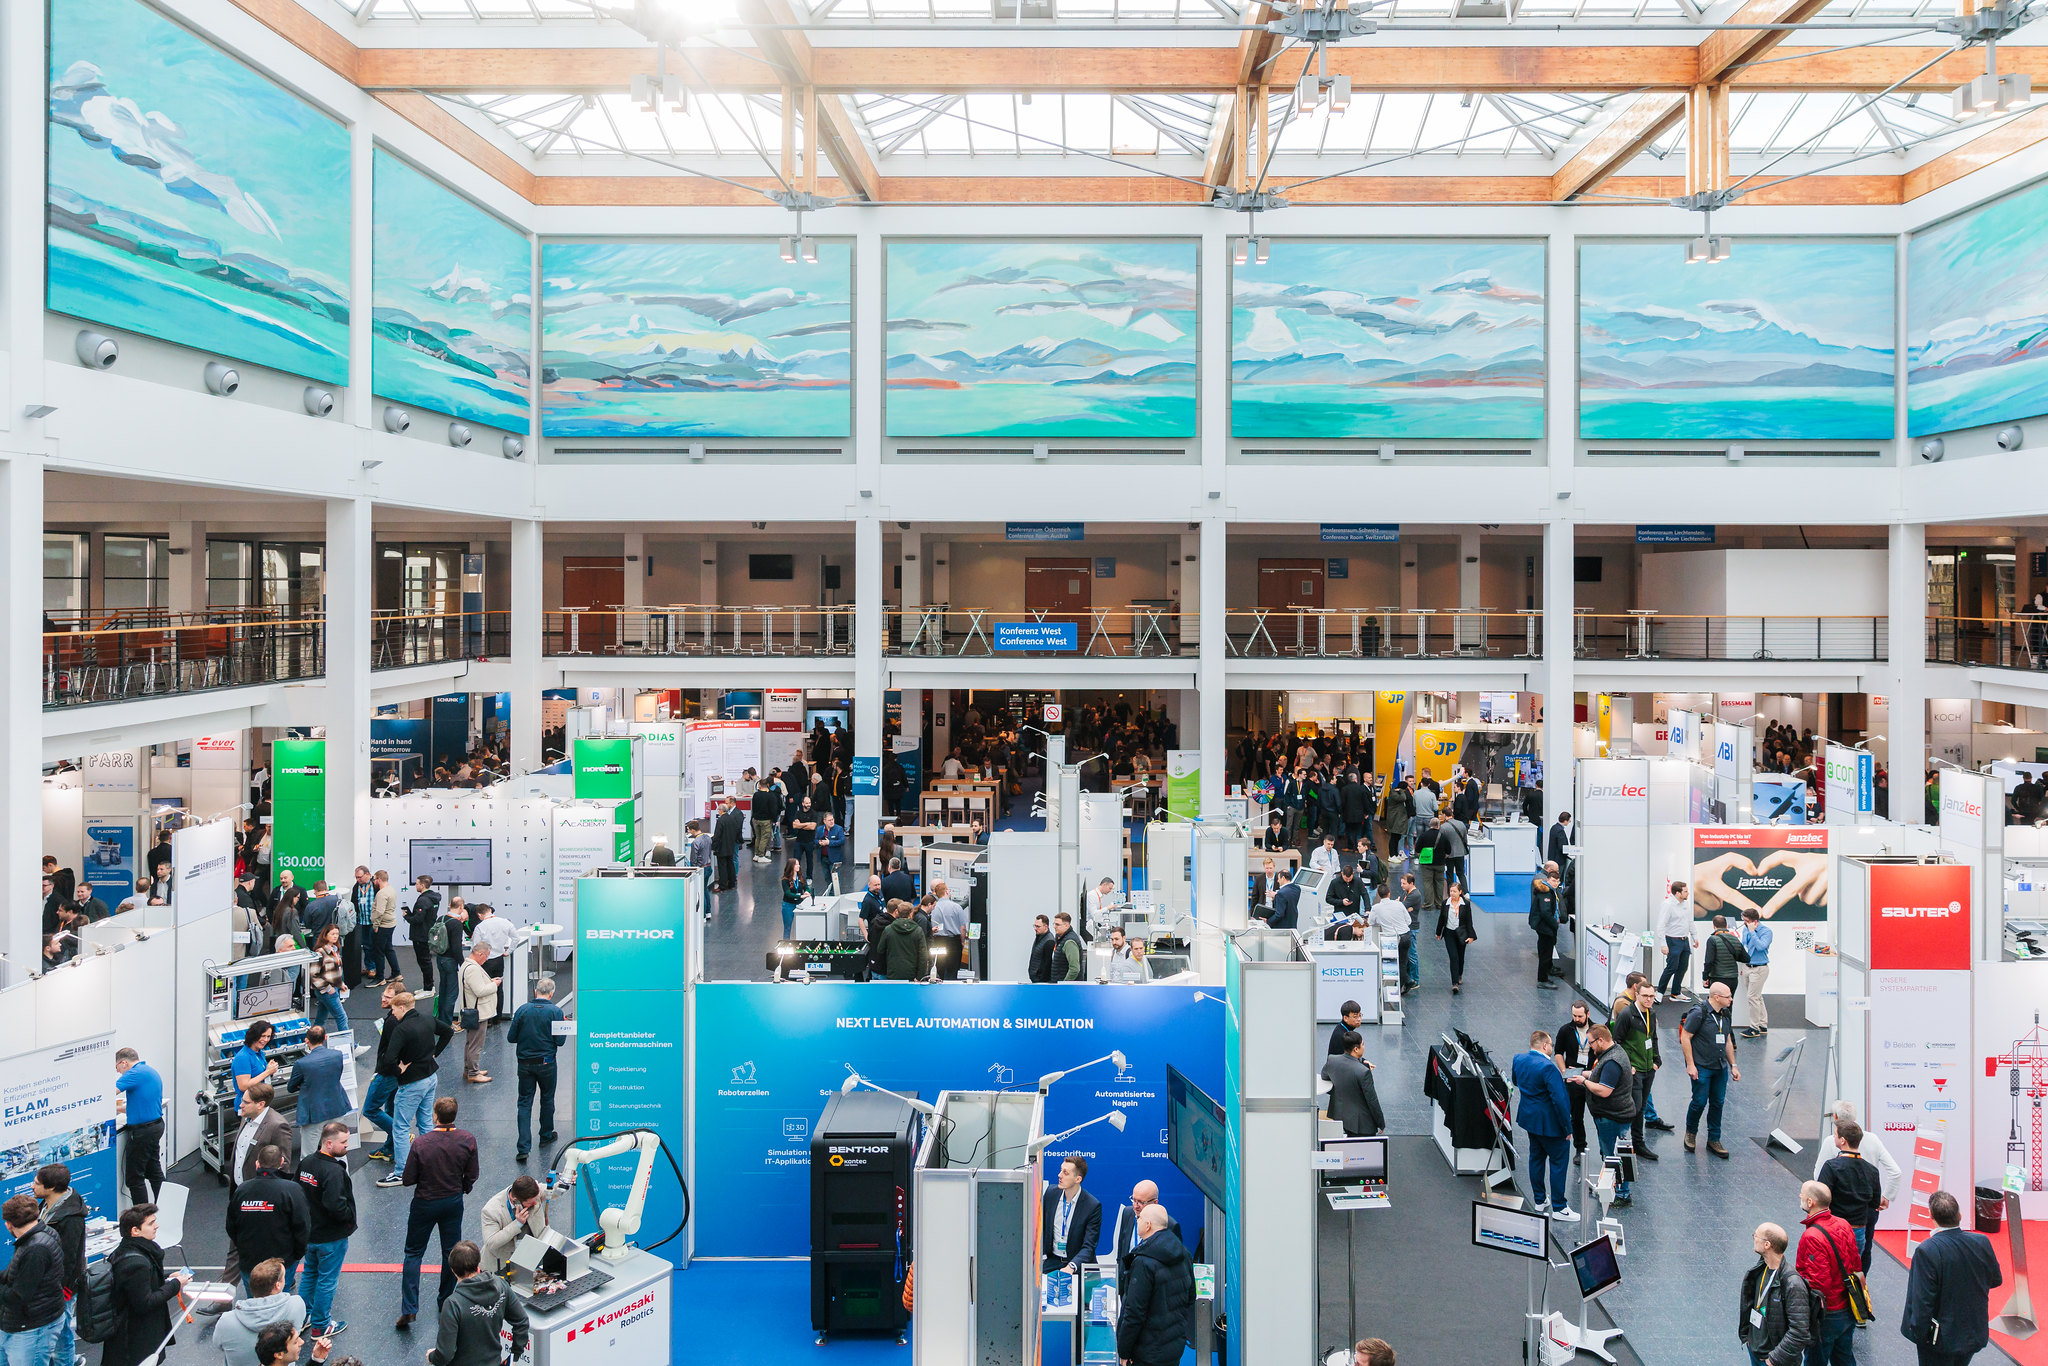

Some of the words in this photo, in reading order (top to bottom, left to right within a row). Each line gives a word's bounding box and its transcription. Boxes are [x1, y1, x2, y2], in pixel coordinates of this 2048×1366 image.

[1000, 626, 1039, 635] Konferenz
[1041, 627, 1062, 635] West
[1000, 637, 1044, 645] Conference
[1046, 637, 1067, 645] West
[770, 694, 798, 703] Seger
[1388, 694, 1404, 704] JP
[1934, 713, 1962, 722] KOCH
[648, 733, 675, 742] DIAS
[1670, 726, 1684, 745] ABI
[211, 739, 236, 747] ever
[1434, 742, 1458, 756] JP
[1717, 741, 1733, 762] ABI
[89, 752, 134, 768] FARR
[281, 766, 323, 774] norelem
[582, 764, 624, 773] norelem
[1585, 783, 1646, 799] janztec
[1942, 795, 1982, 817] janztec
[1785, 833, 1823, 843] janztec
[277, 856, 325, 868] 130.000
[1736, 876, 1783, 889] janztec
[1881, 906, 1950, 918] SAUTER
[585, 929, 675, 940] BENTHOR
[1586, 941, 1608, 967] janztec
[1321, 967, 1364, 977] KISTLER
[1879, 976, 1907, 984] UNSERE
[1879, 985, 1938, 993] SYSTEMPARTNER
[836, 1017, 871, 1029] NEXT
[873, 1017, 913, 1029] LEVEL
[915, 1017, 1000, 1029] AUTOMATION
[1002, 1017, 1012, 1029] &
[1015, 1017, 1094, 1029] SIMULATION
[589, 1031, 656, 1040] Komplettanbieter
[74, 1040, 110, 1053] ARMBRUSTER
[1892, 1041, 1917, 1049] Belden
[3, 1082, 31, 1095] Kosten
[33, 1075, 61, 1088] senken
[3, 1091, 37, 1104] Effizienz
[38, 1081, 69, 1095] steigern
[718, 1089, 770, 1097] Roboterzellen
[1094, 1090, 1156, 1098] Automatisiertes
[4, 1097, 49, 1119] ELAM
[1112, 1099, 1139, 1108] Nageln
[3, 1094, 103, 1128] WERKERASSISTENZ
[1884, 1121, 1916, 1131] HUGRO
[828, 1145, 889, 1154] BENTHOR
[764, 1158, 811, 1166] IT-Applikatio
[608, 1165, 633, 1173] Montage
[597, 1290, 655, 1328] Kawasaki
[620, 1306, 654, 1329] Robotics
